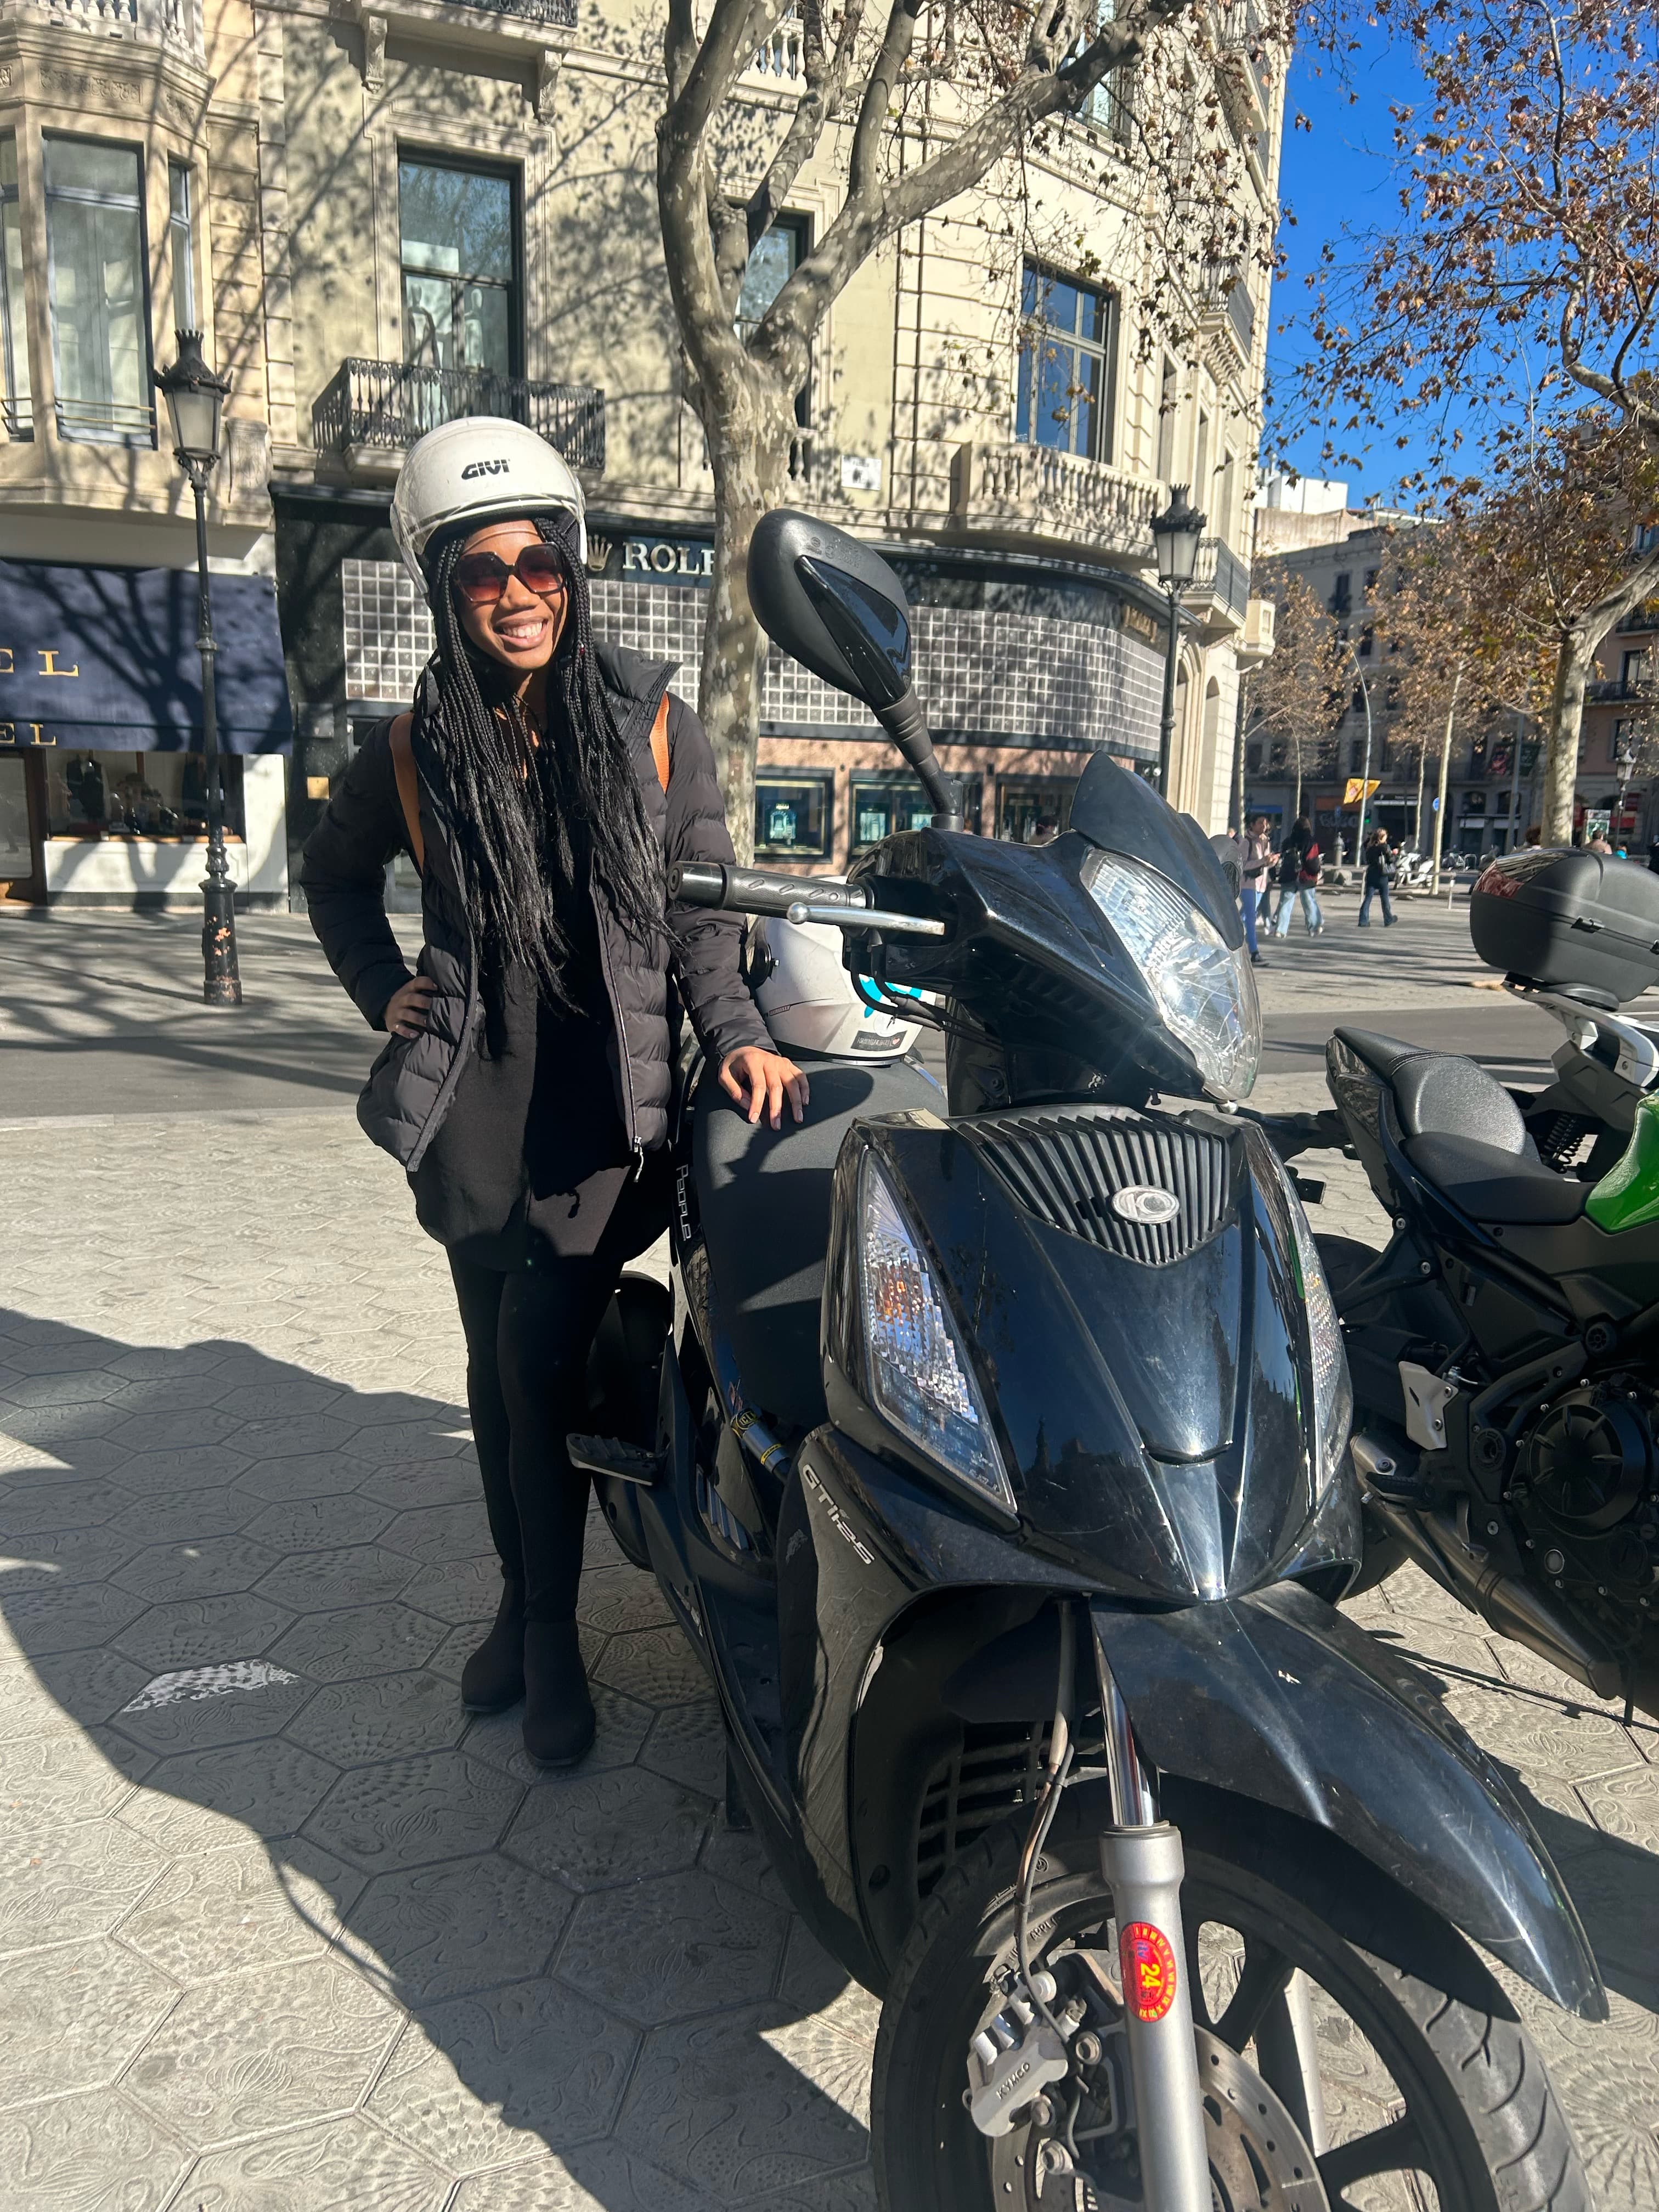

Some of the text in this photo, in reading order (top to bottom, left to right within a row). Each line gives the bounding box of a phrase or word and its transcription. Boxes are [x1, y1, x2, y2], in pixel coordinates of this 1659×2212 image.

[461, 459, 510, 481] GIVI
[622, 541, 715, 575] ROLE
[1141, 1963, 1160, 1988] 24
[996, 2062, 1030, 2100] KYMCO
